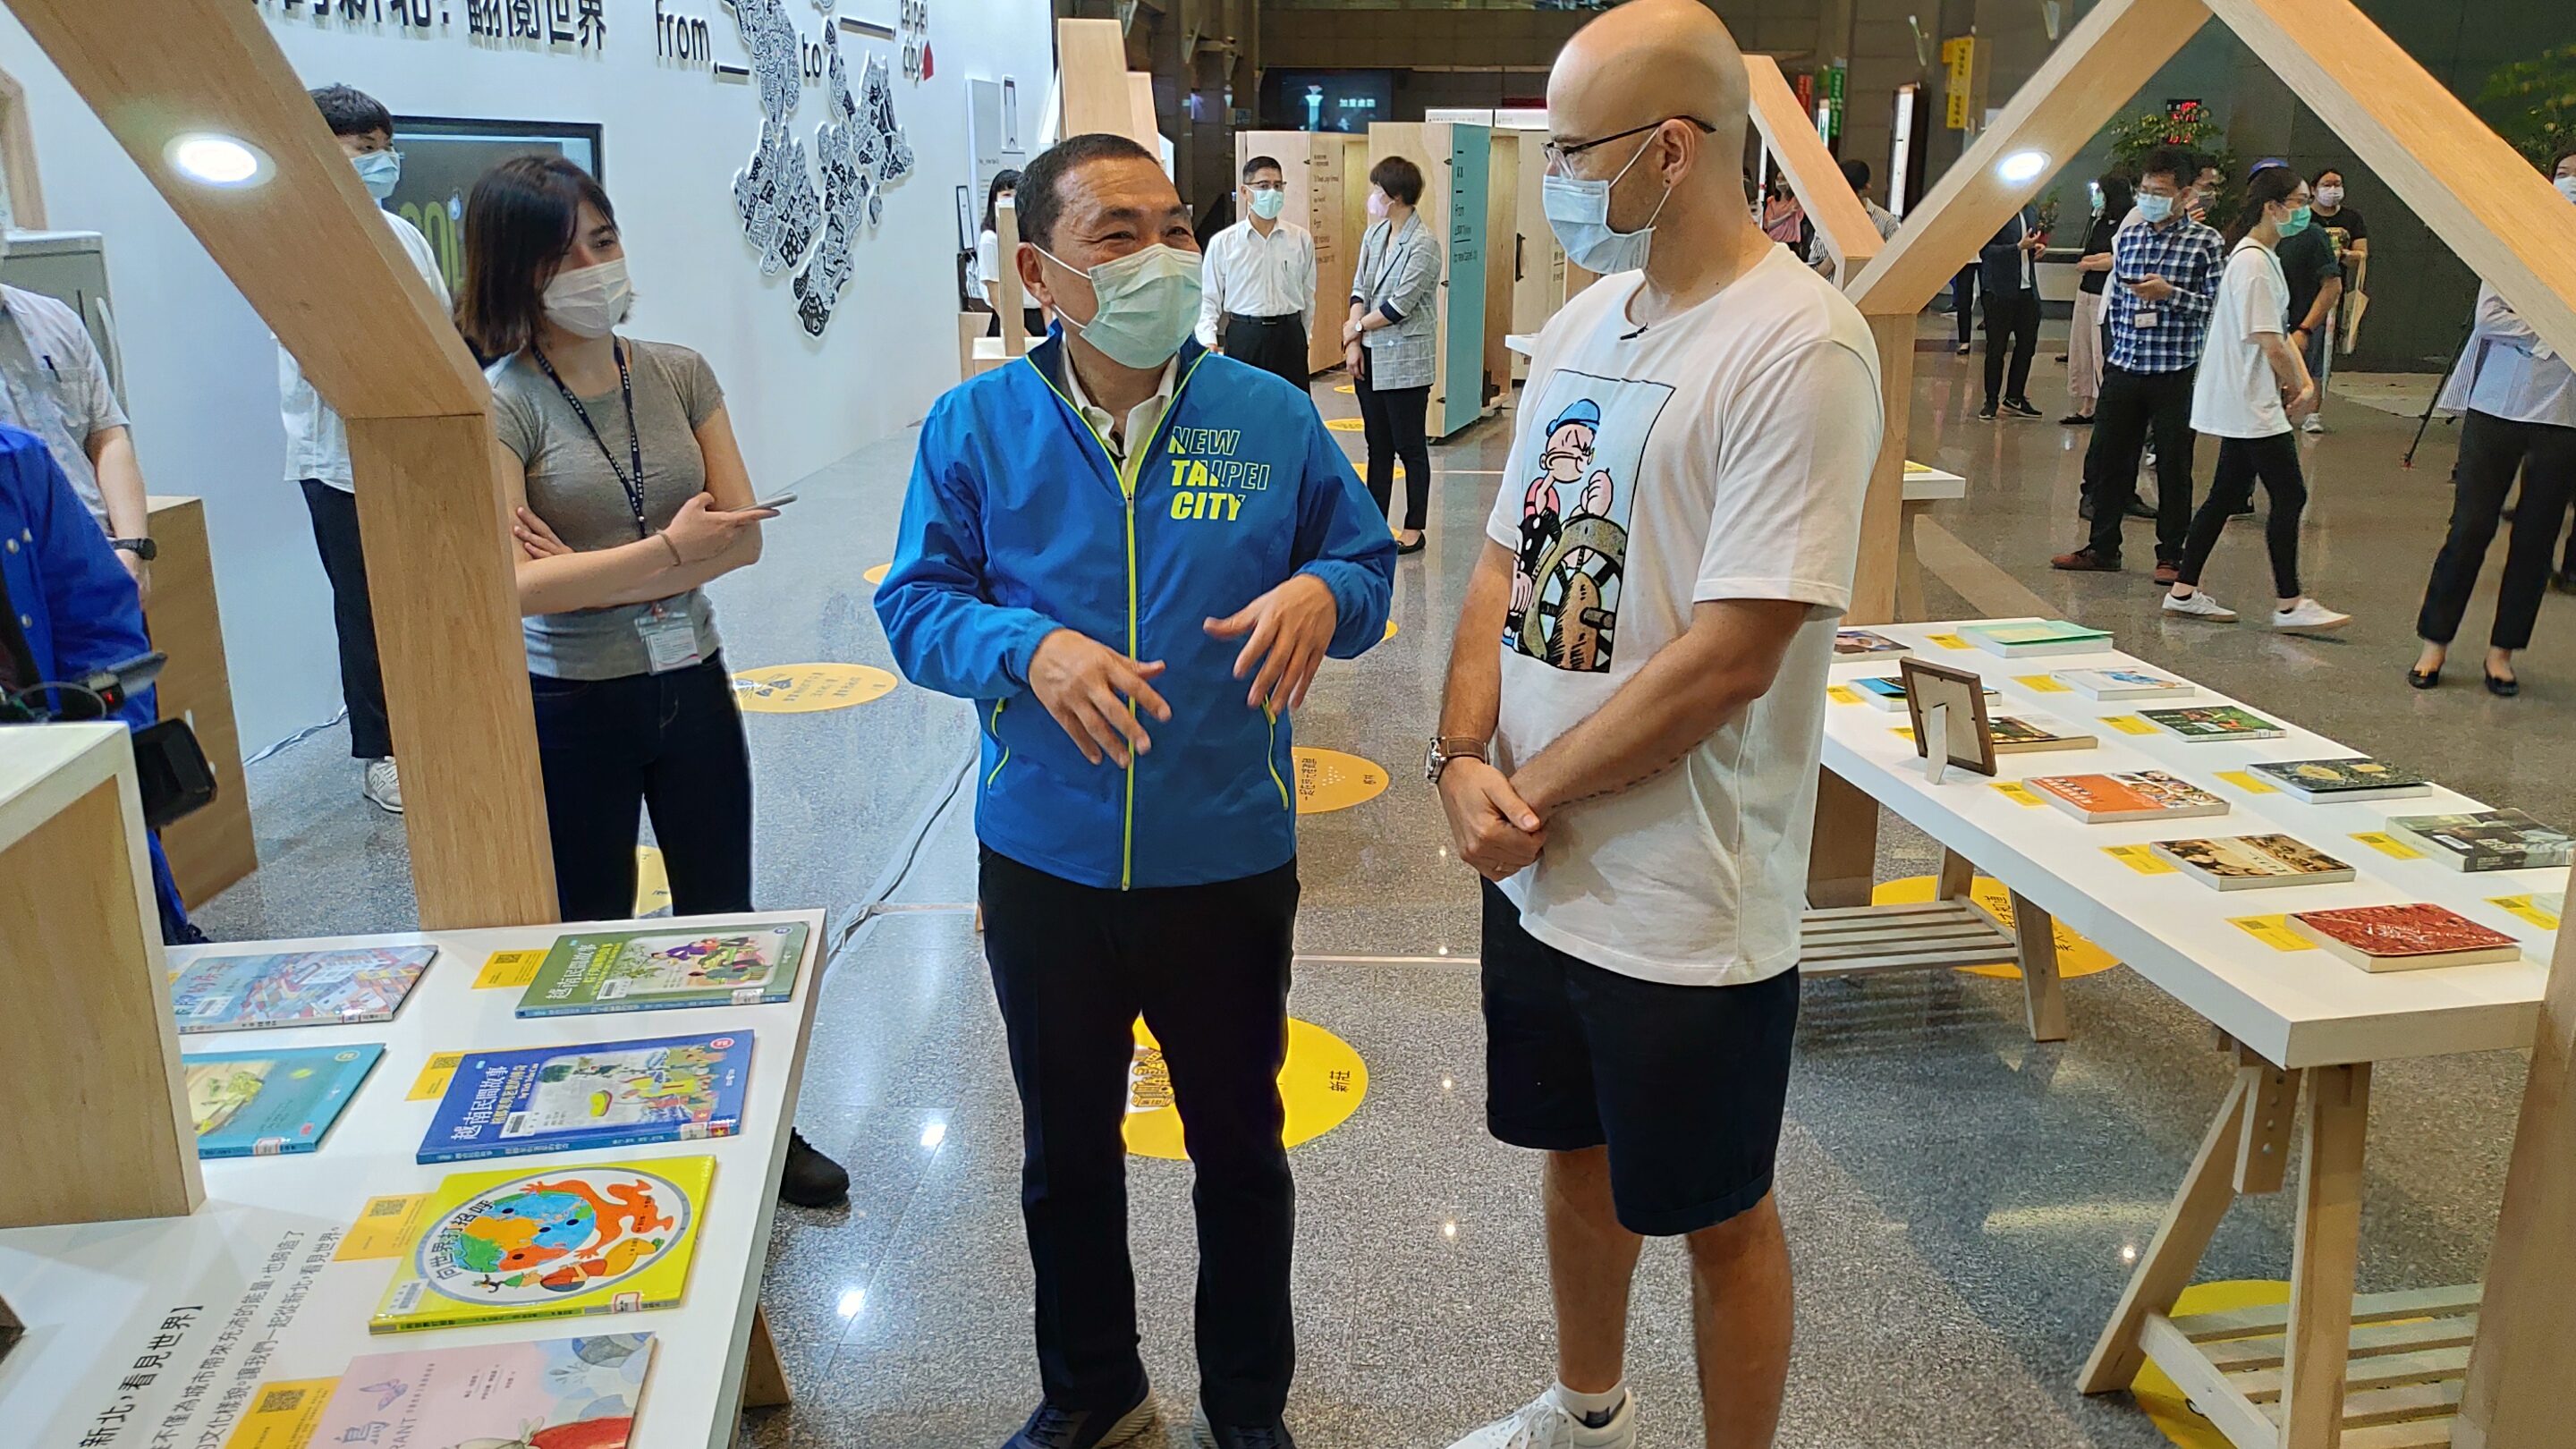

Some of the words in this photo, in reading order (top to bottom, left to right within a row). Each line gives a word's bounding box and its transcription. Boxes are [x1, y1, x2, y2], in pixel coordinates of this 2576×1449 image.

[801, 32, 823, 79] to
[1167, 426, 1241, 456] NEW
[1171, 460, 1271, 490] TAIPEI
[1170, 491, 1247, 521] CITY
[451, 1065, 509, 1140] 越南民間故事
[436, 1199, 496, 1281] 向世界打招呼
